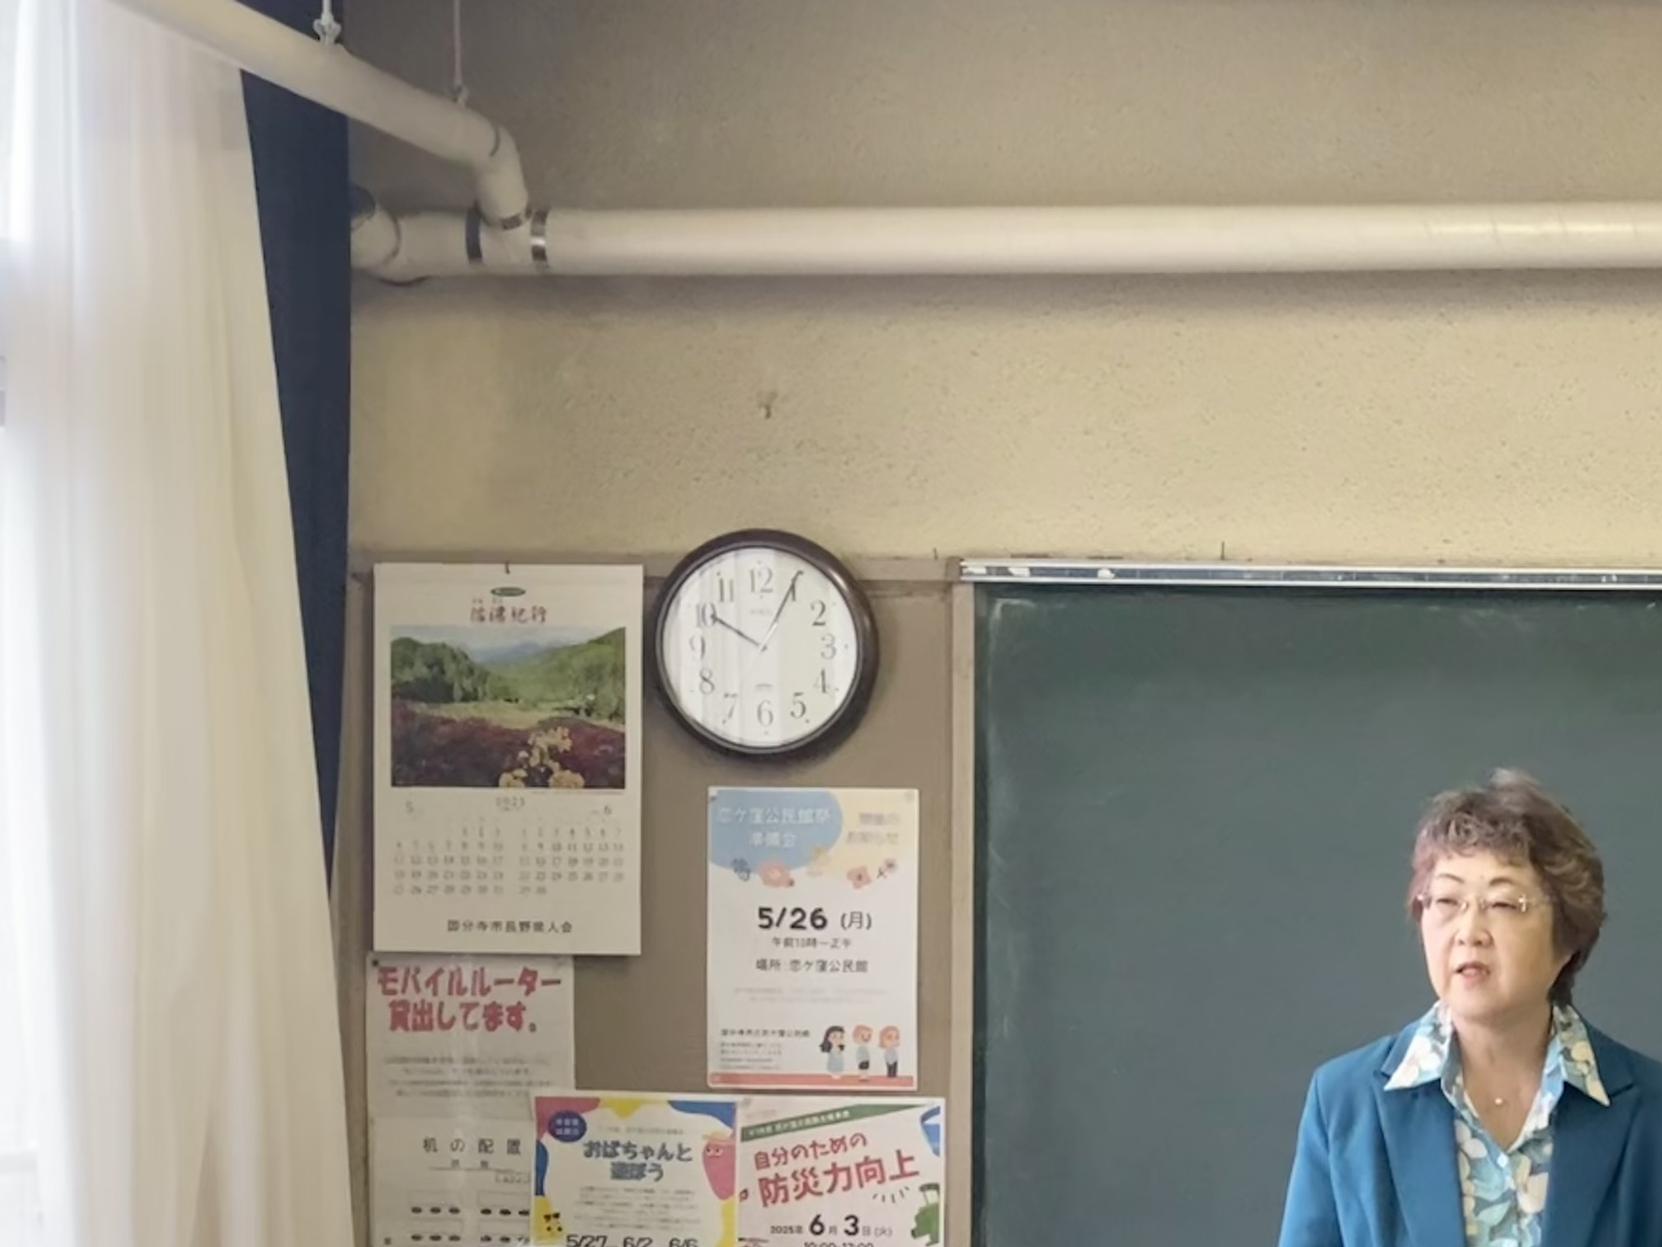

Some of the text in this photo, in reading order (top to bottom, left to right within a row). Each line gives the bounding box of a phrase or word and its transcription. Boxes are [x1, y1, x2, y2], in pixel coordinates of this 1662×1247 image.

[719, 578, 734, 602] 11
[751, 568, 773, 593] 12
[811, 600, 826, 626] 2
[689, 635, 706, 660] 9
[820, 633, 836, 660] 3
[700, 668, 715, 694] 8
[757, 700, 774, 727] 6
[790, 692, 806, 718] 5
[758, 906, 873, 930] 5/26 (月)
[378, 966, 562, 997] モバイルルーター
[389, 999, 537, 1033] 貸出してます。
[423, 1137, 521, 1155] 机の配置
[754, 1132, 868, 1170] 自分のための
[758, 1149, 920, 1207] 防災力向上
